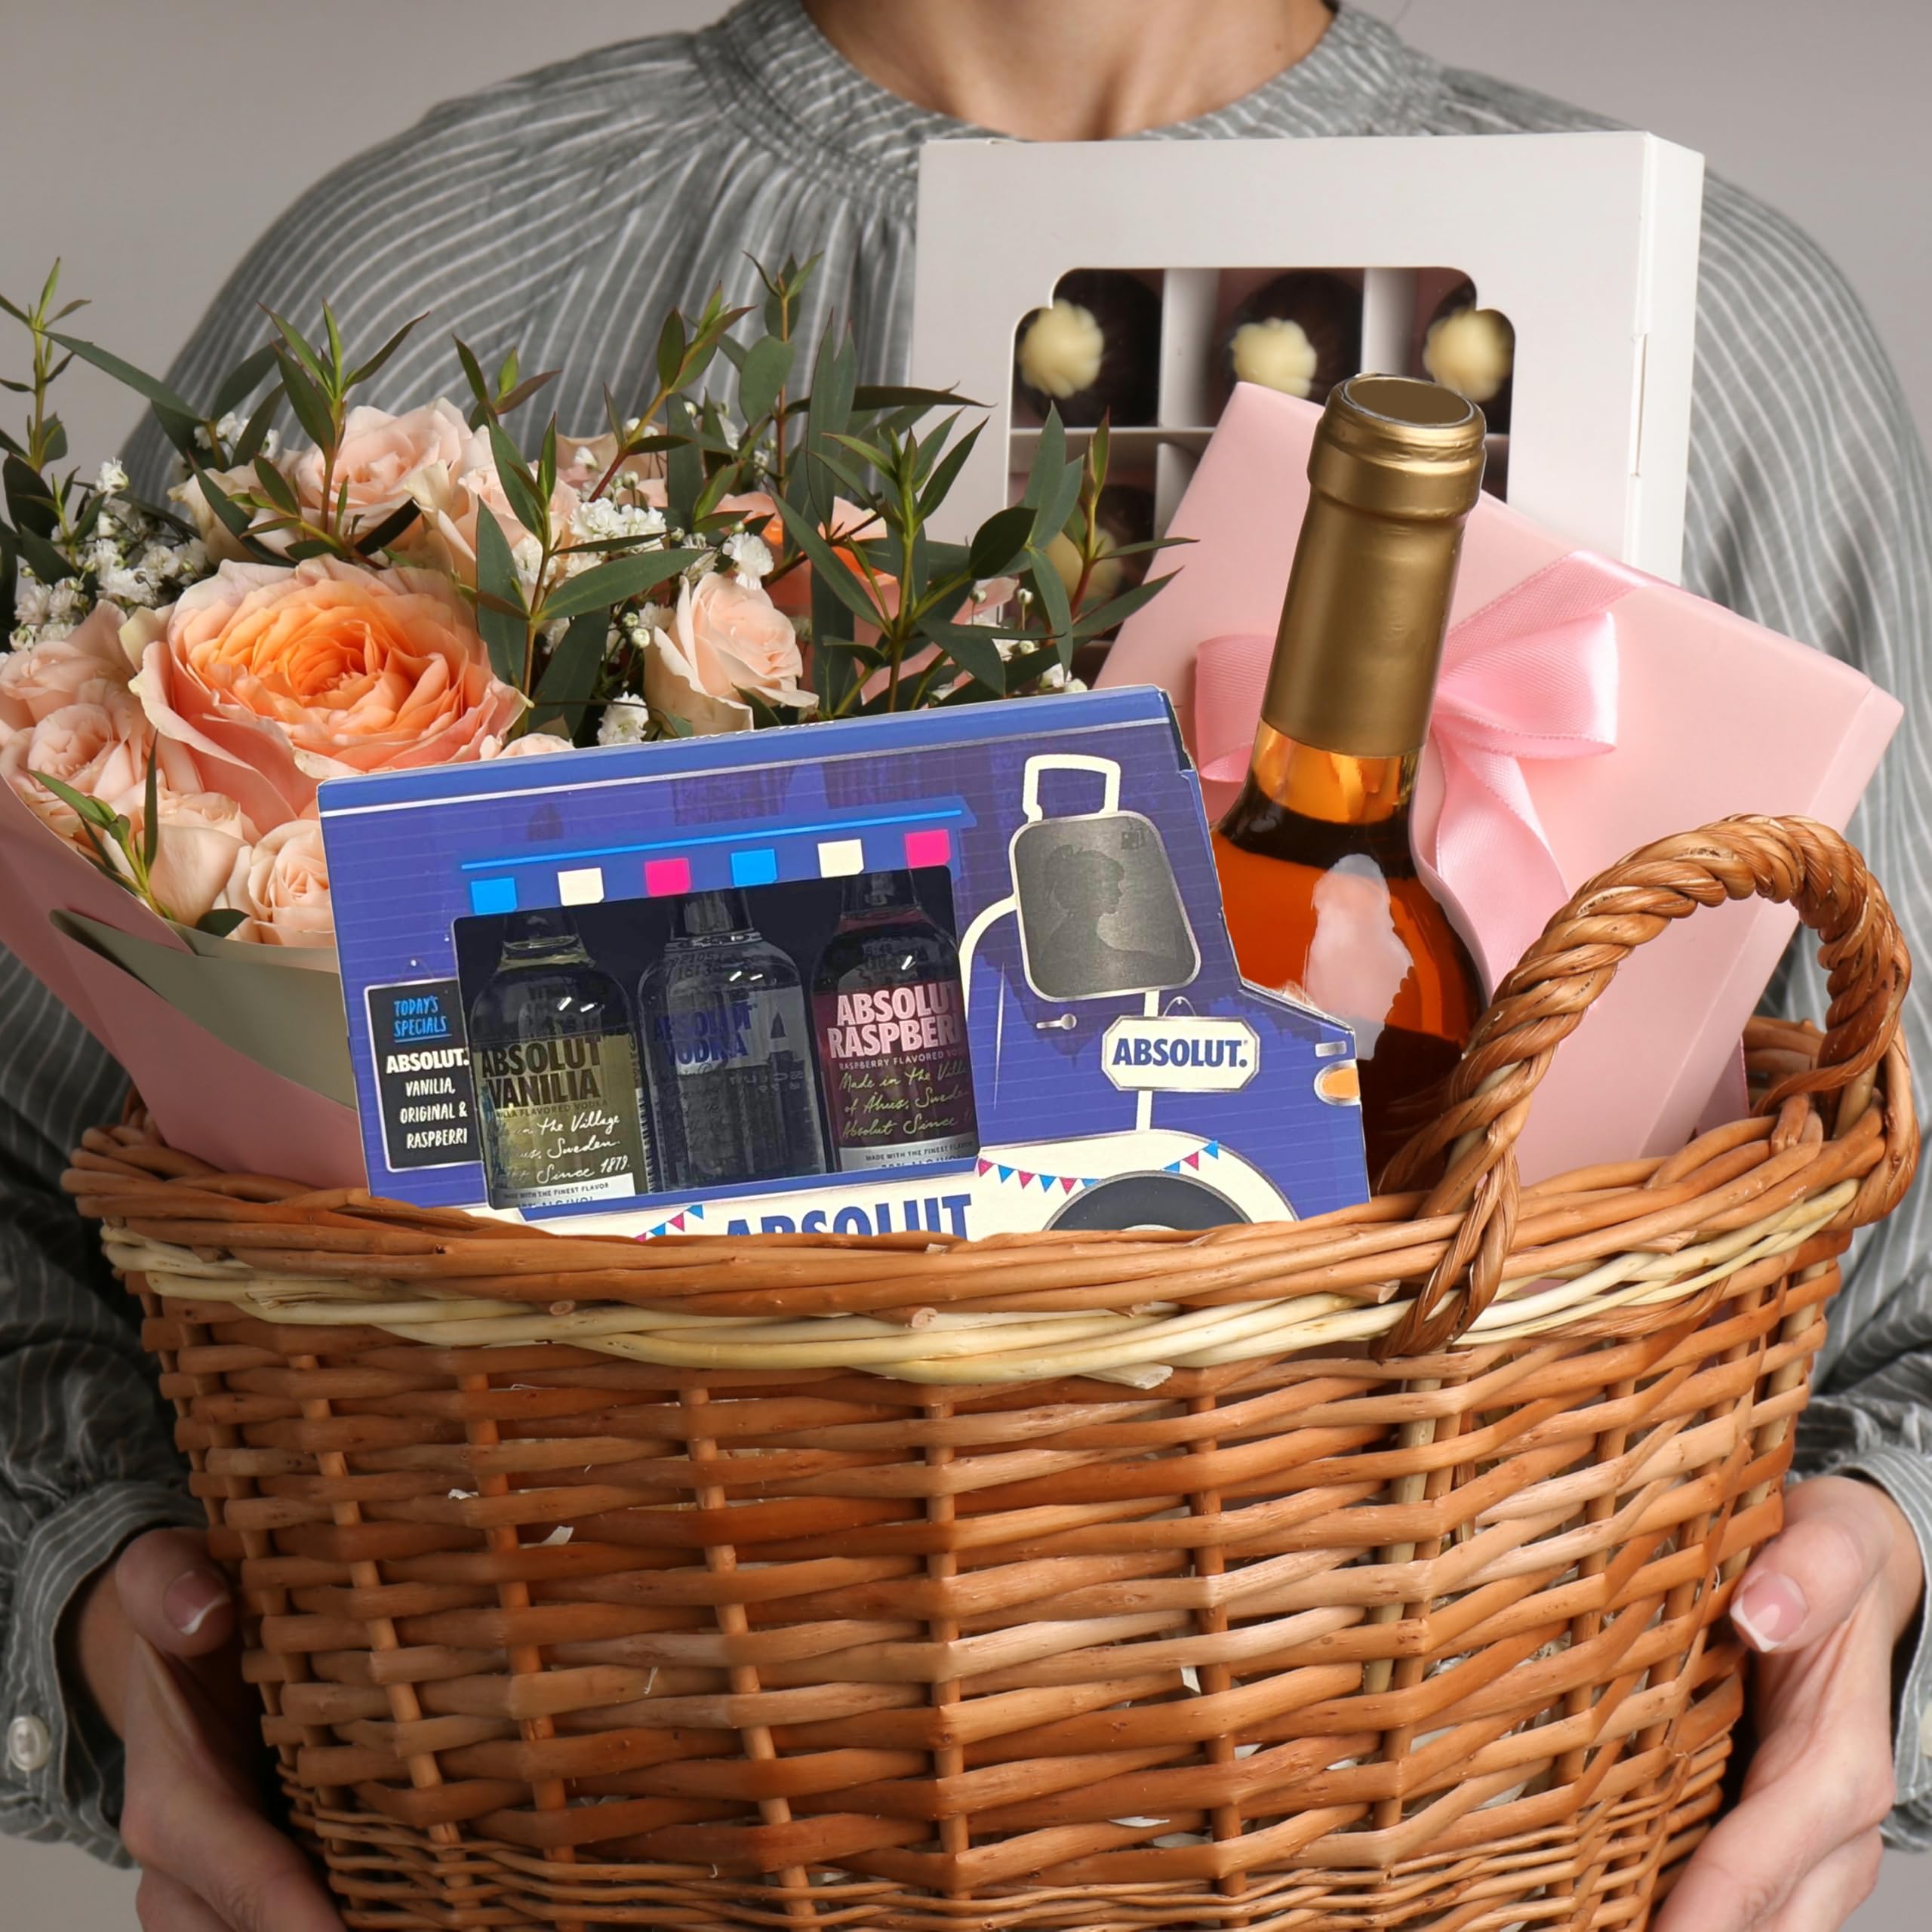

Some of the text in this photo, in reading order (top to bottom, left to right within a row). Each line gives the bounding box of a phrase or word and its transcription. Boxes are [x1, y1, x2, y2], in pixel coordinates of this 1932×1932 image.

[393, 995, 439, 1017] TODAY'S
[394, 1015, 447, 1038] SPECIALS
[481, 1035, 602, 1078] ABSOLUT
[894, 1051, 944, 1066] FLAVORED
[486, 1069, 601, 1110] VANILIA
[838, 1072, 875, 1091] Made
[879, 1075, 901, 1087] in
[904, 1066, 931, 1085] the
[399, 1101, 468, 1124] ORIGINAL &
[519, 1103, 571, 1117] FLAVORED
[574, 1100, 609, 1111] VODKA
[844, 1097, 860, 1117] of
[537, 1117, 565, 1136] the
[571, 1109, 620, 1135] Village
[842, 1118, 898, 1140] Absolut
[903, 1113, 959, 1136] Since
[406, 1127, 468, 1149] RASPBERRI
[886, 1152, 906, 1161] WITH
[923, 1145, 949, 1155] FINEST
[536, 1163, 595, 1184] Since
[520, 1191, 537, 1199] WITH
[537, 1189, 552, 1198] THE
[553, 1186, 580, 1196] FINEST
[581, 1182, 609, 1192] FLAVOR
